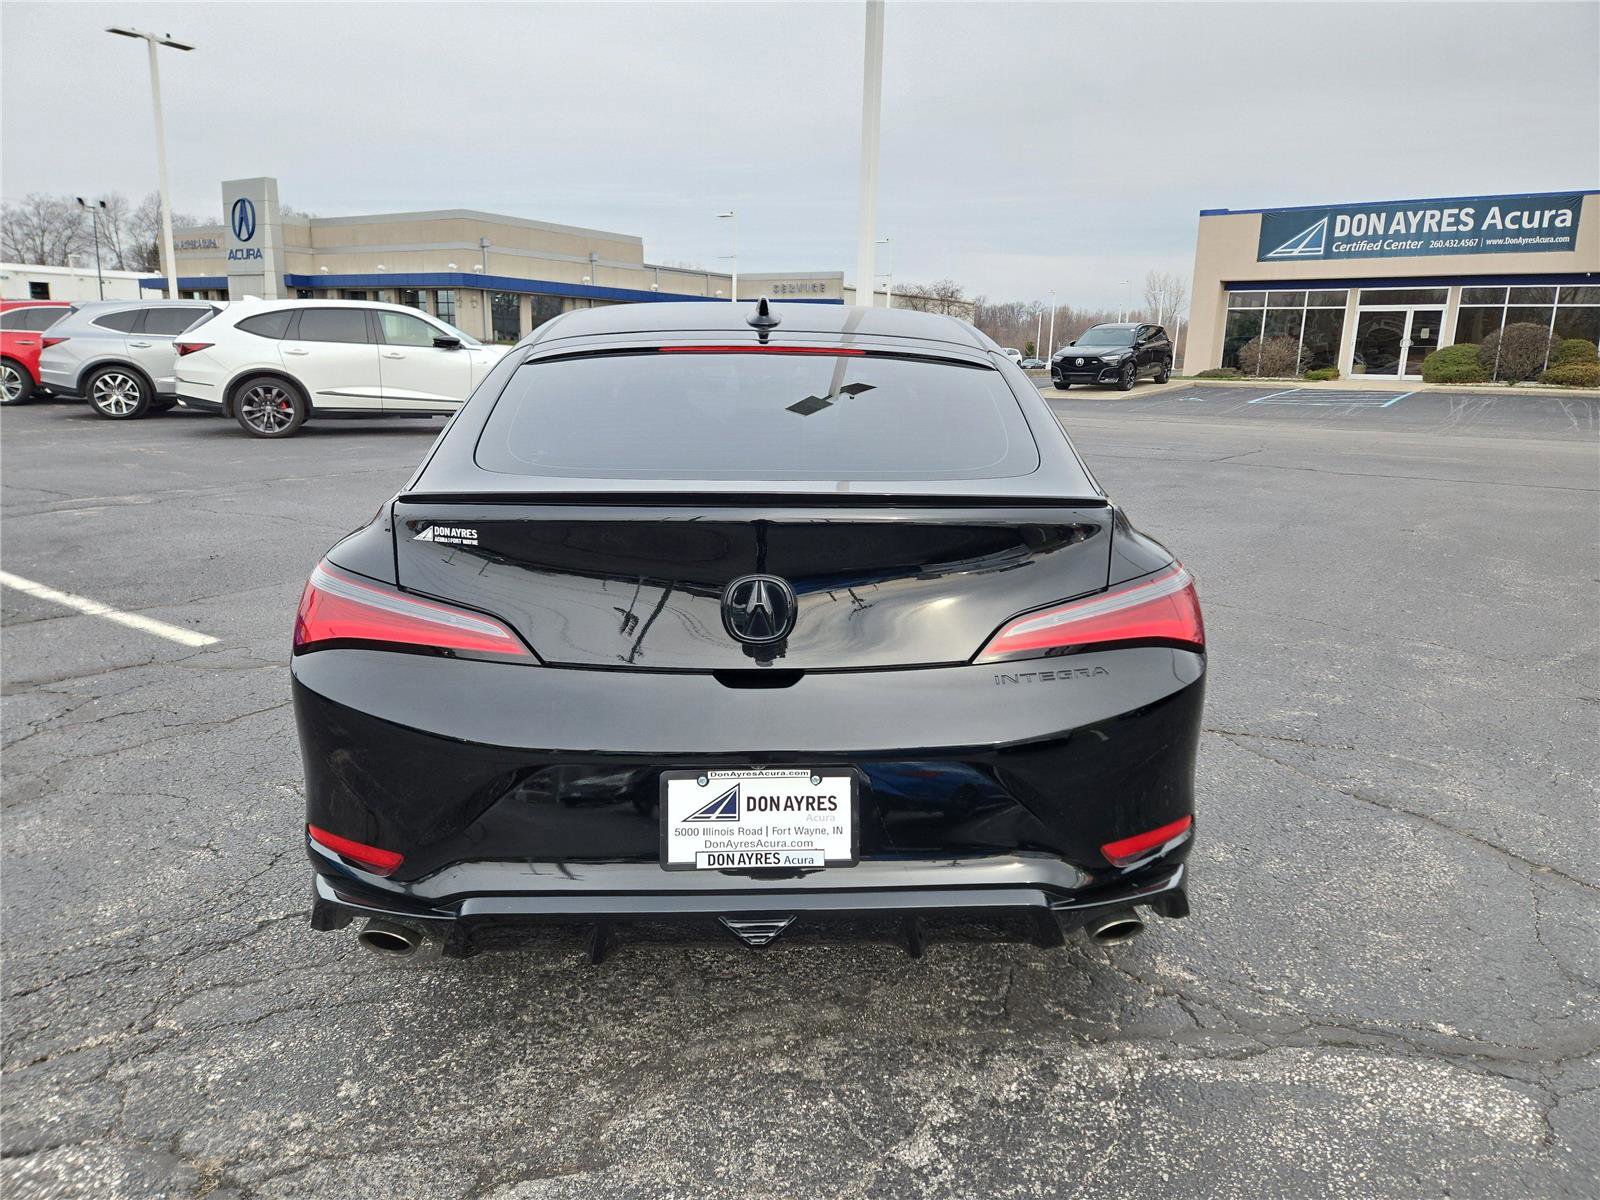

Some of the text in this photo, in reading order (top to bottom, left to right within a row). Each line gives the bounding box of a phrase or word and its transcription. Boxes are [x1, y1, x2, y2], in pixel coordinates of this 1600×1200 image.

[1334, 206, 1573, 237] DON AYRES Acura
[1332, 236, 1570, 253] Certified Center 260.432.4567 www.DonAyresAcura.com
[227, 247, 263, 261] ACURA
[773, 283, 825, 294] SERVICE
[434, 526, 478, 538] DON AYRES
[994, 666, 1110, 686] INTEGRA
[746, 795, 838, 812] DON AYRES
[806, 813, 836, 823] Acura
[674, 826, 843, 837] 5000 Illinois Road Fort Wayne, IN
[704, 839, 814, 850] DonAyresAcura.com
[707, 852, 814, 867] DON AYRES Acura
